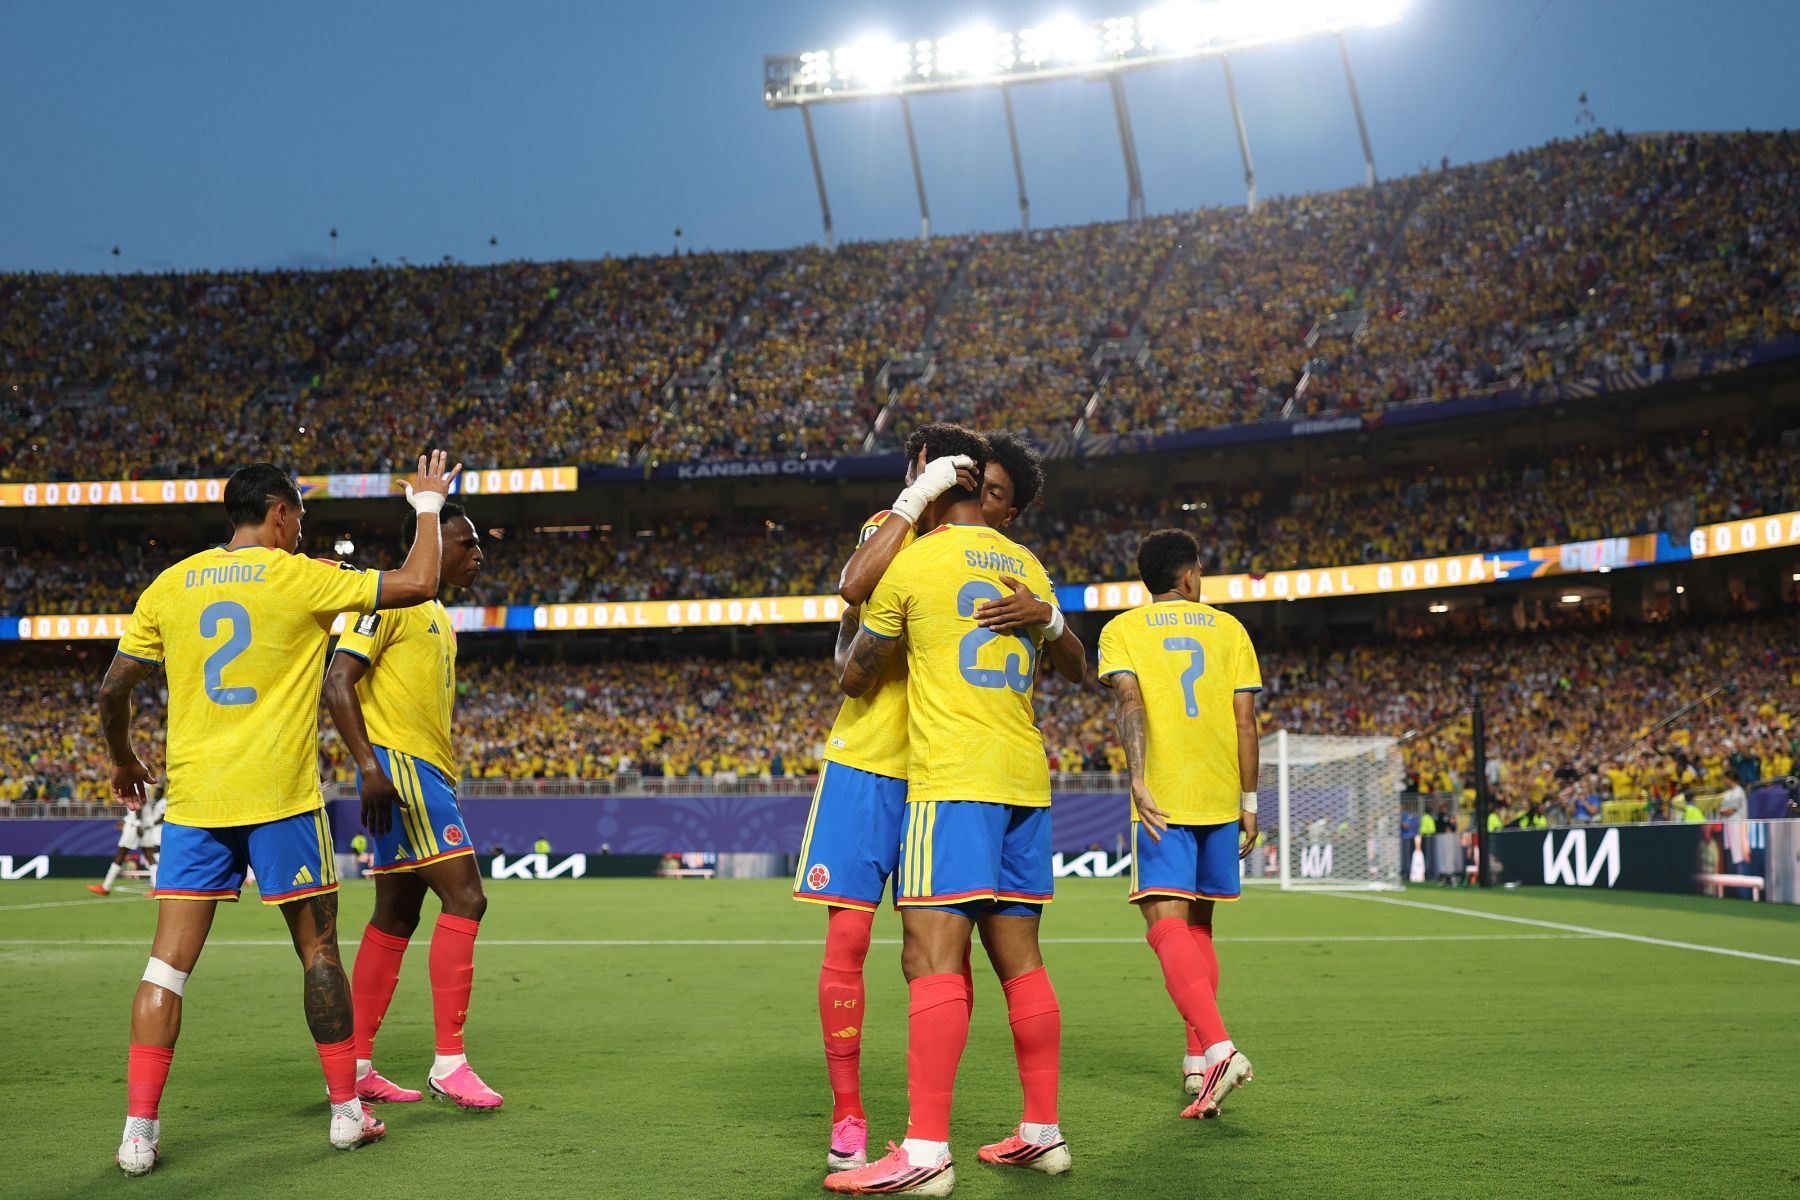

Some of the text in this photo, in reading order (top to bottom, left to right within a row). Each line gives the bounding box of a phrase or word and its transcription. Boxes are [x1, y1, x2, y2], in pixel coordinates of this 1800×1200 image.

[678, 460, 777, 479] KANSAS
[23, 480, 220, 506] GOOOAL GOO
[185, 562, 267, 588] D.MUÑOZ
[965, 546, 1027, 578] SUÁREZ
[1228, 555, 1509, 599] GOOOAL GOOOAL
[18, 617, 126, 639] GOOOAL
[534, 604, 648, 629] GOOOAL
[667, 601, 784, 625] GOOOAL
[1146, 612, 1178, 627] LUIS
[200, 600, 258, 705] 2
[1163, 637, 1205, 718] 7
[0, 855, 49, 880] IA
[491, 853, 587, 879] KIA
[1543, 827, 1621, 888] KIA
